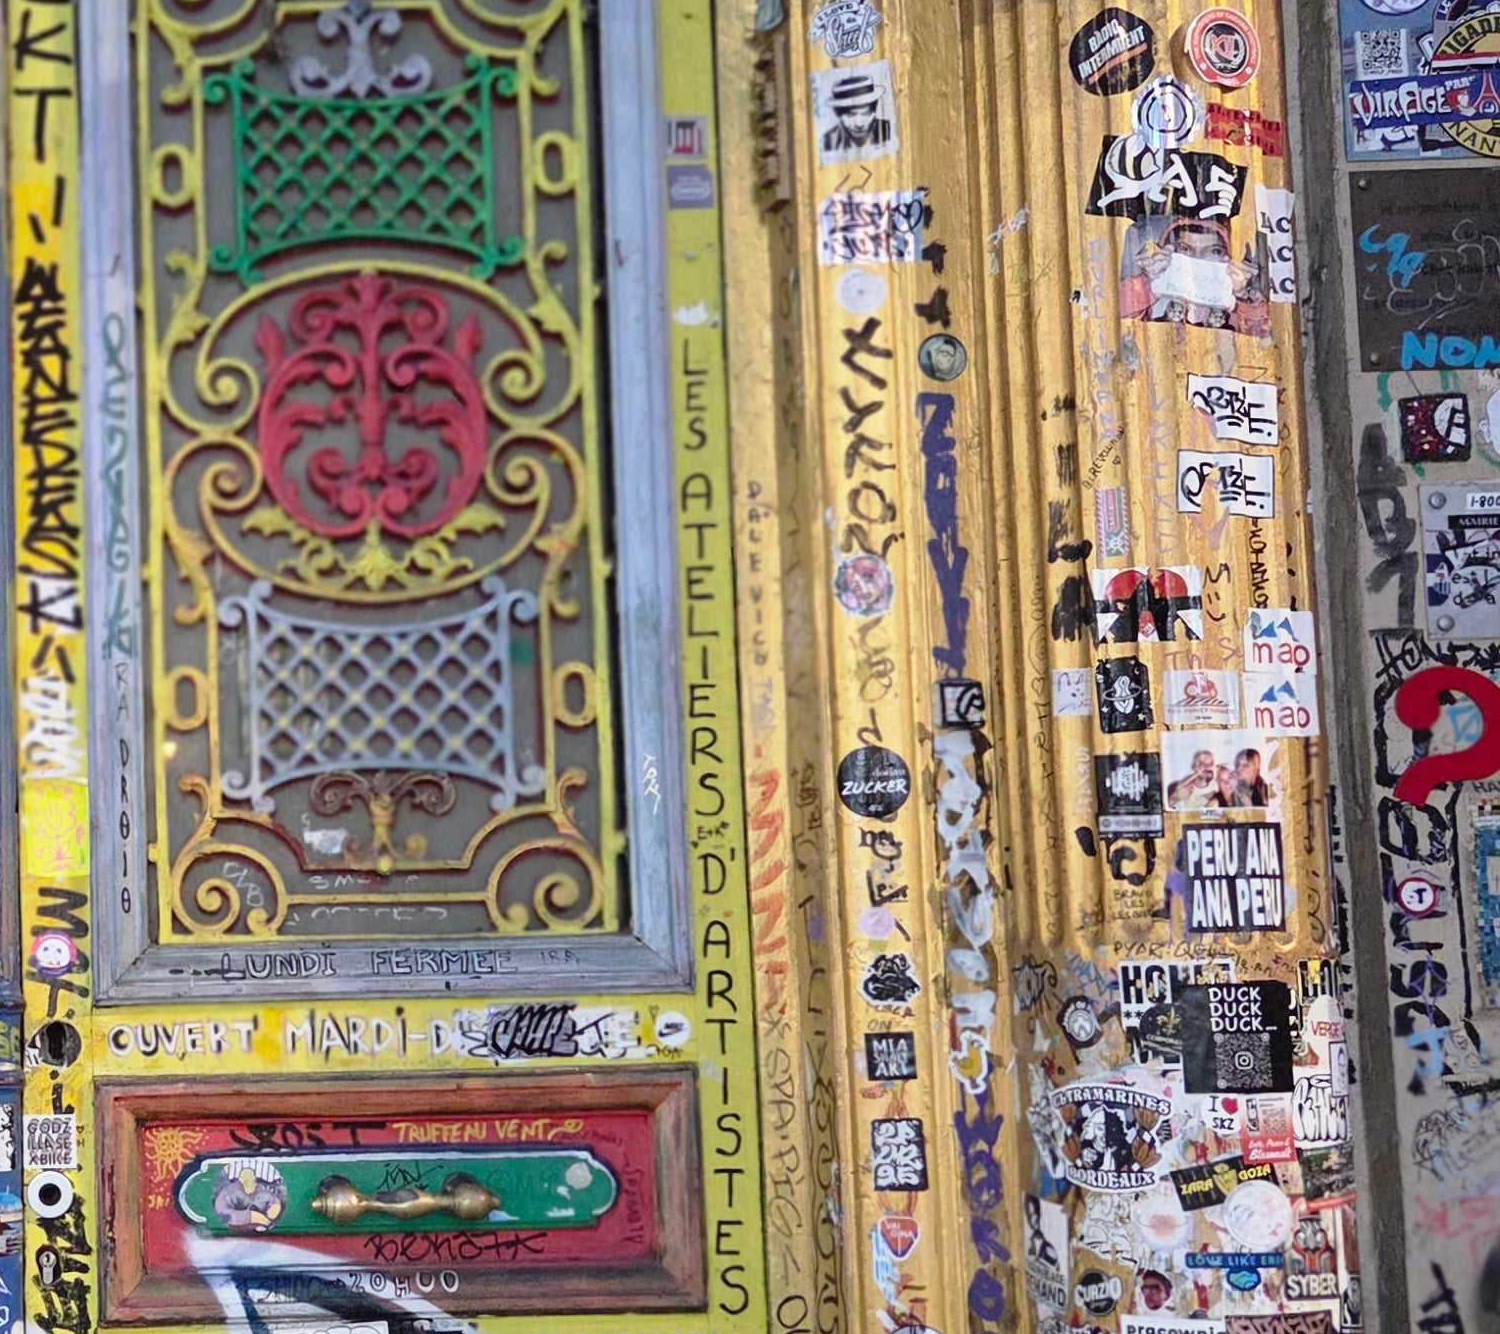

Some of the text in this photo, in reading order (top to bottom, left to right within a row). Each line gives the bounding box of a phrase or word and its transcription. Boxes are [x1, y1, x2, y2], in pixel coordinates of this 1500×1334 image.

[1351, 82, 1451, 126] VIRAGE
[681, 473, 725, 816] ATELIERS
[1252, 643, 1311, 670] mao
[1252, 704, 1311, 730] mao
[841, 777, 909, 795] ZUCKER
[1187, 828, 1281, 877] PERU ANA
[1192, 878, 1282, 927] ANA PERU
[222, 945, 336, 980] LUNDI
[1208, 986, 1261, 1003] DUCK
[1210, 1001, 1262, 1017] DUCK
[109, 1019, 258, 1059] OUVERT
[1212, 1117, 1235, 1131] SKZ
[1180, 1177, 1214, 1196] ZARA
[1227, 1255, 1256, 1266] LIKE
[1287, 1273, 1337, 1297] SYBER
